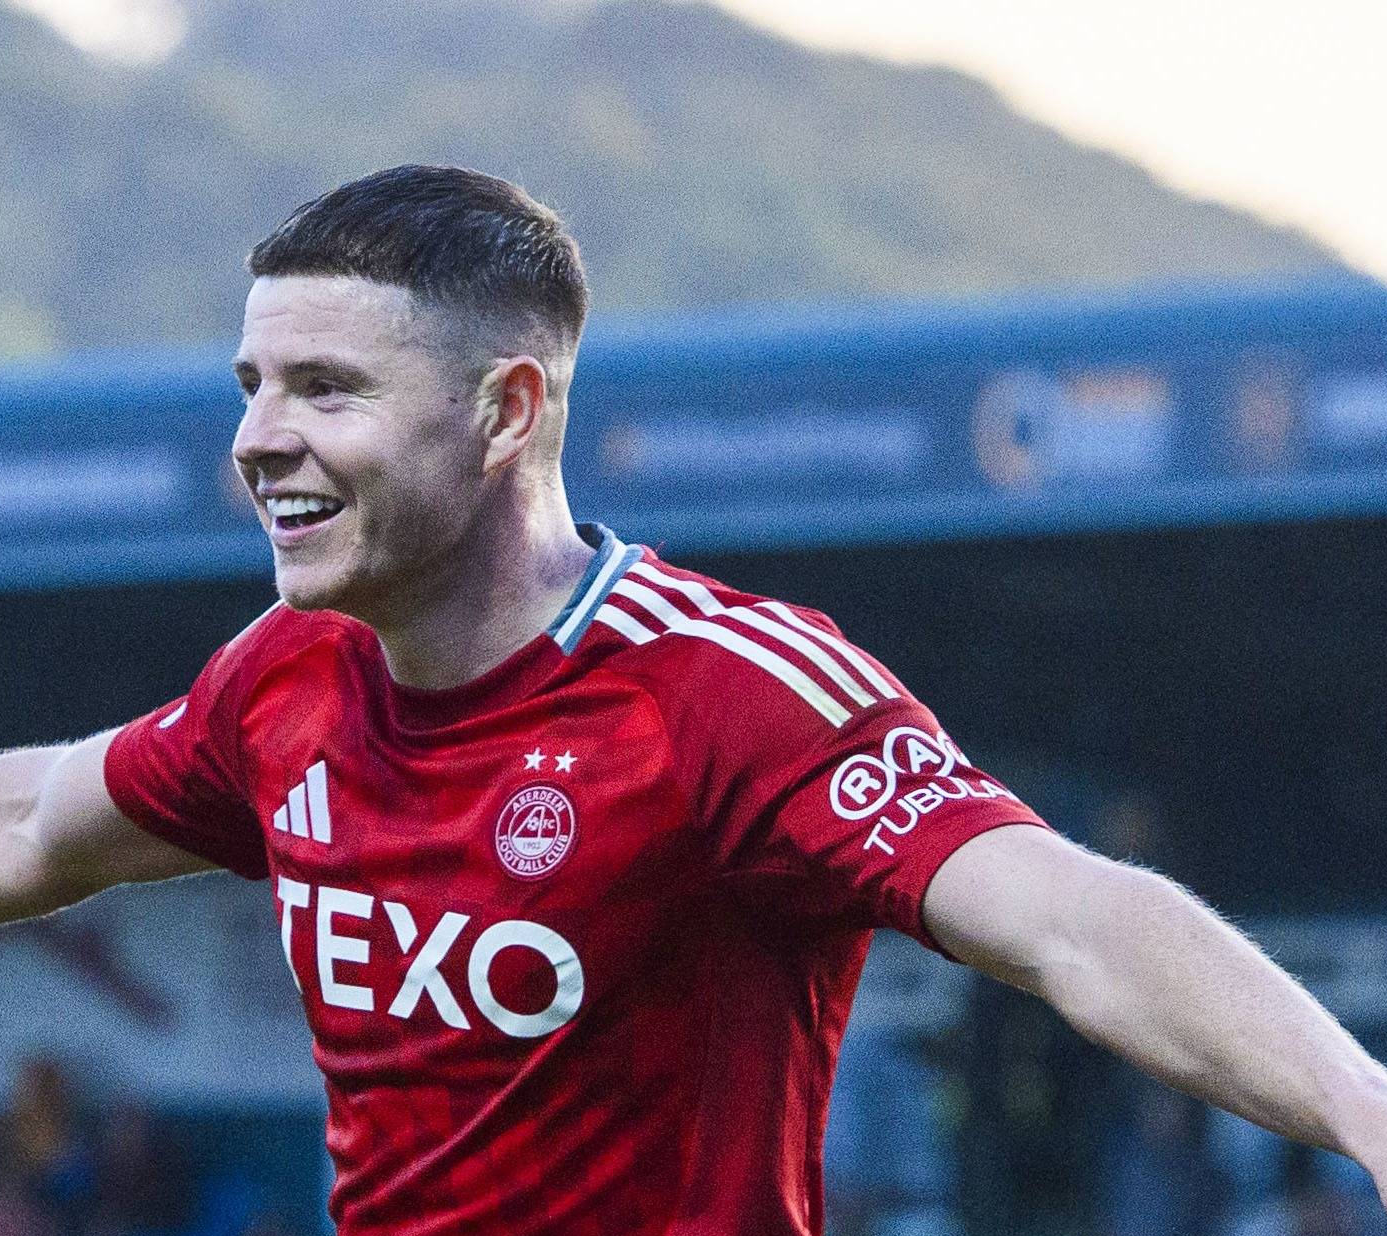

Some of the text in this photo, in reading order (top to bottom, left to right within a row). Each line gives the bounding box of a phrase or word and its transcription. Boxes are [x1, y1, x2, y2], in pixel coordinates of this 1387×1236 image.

[512, 790, 567, 812] ABERDEEN
[829, 727, 971, 820] RA
[498, 834, 569, 872] FOOTBALL CLUB
[863, 776, 1021, 855] TUBULA
[276, 874, 585, 1038] TEXO
